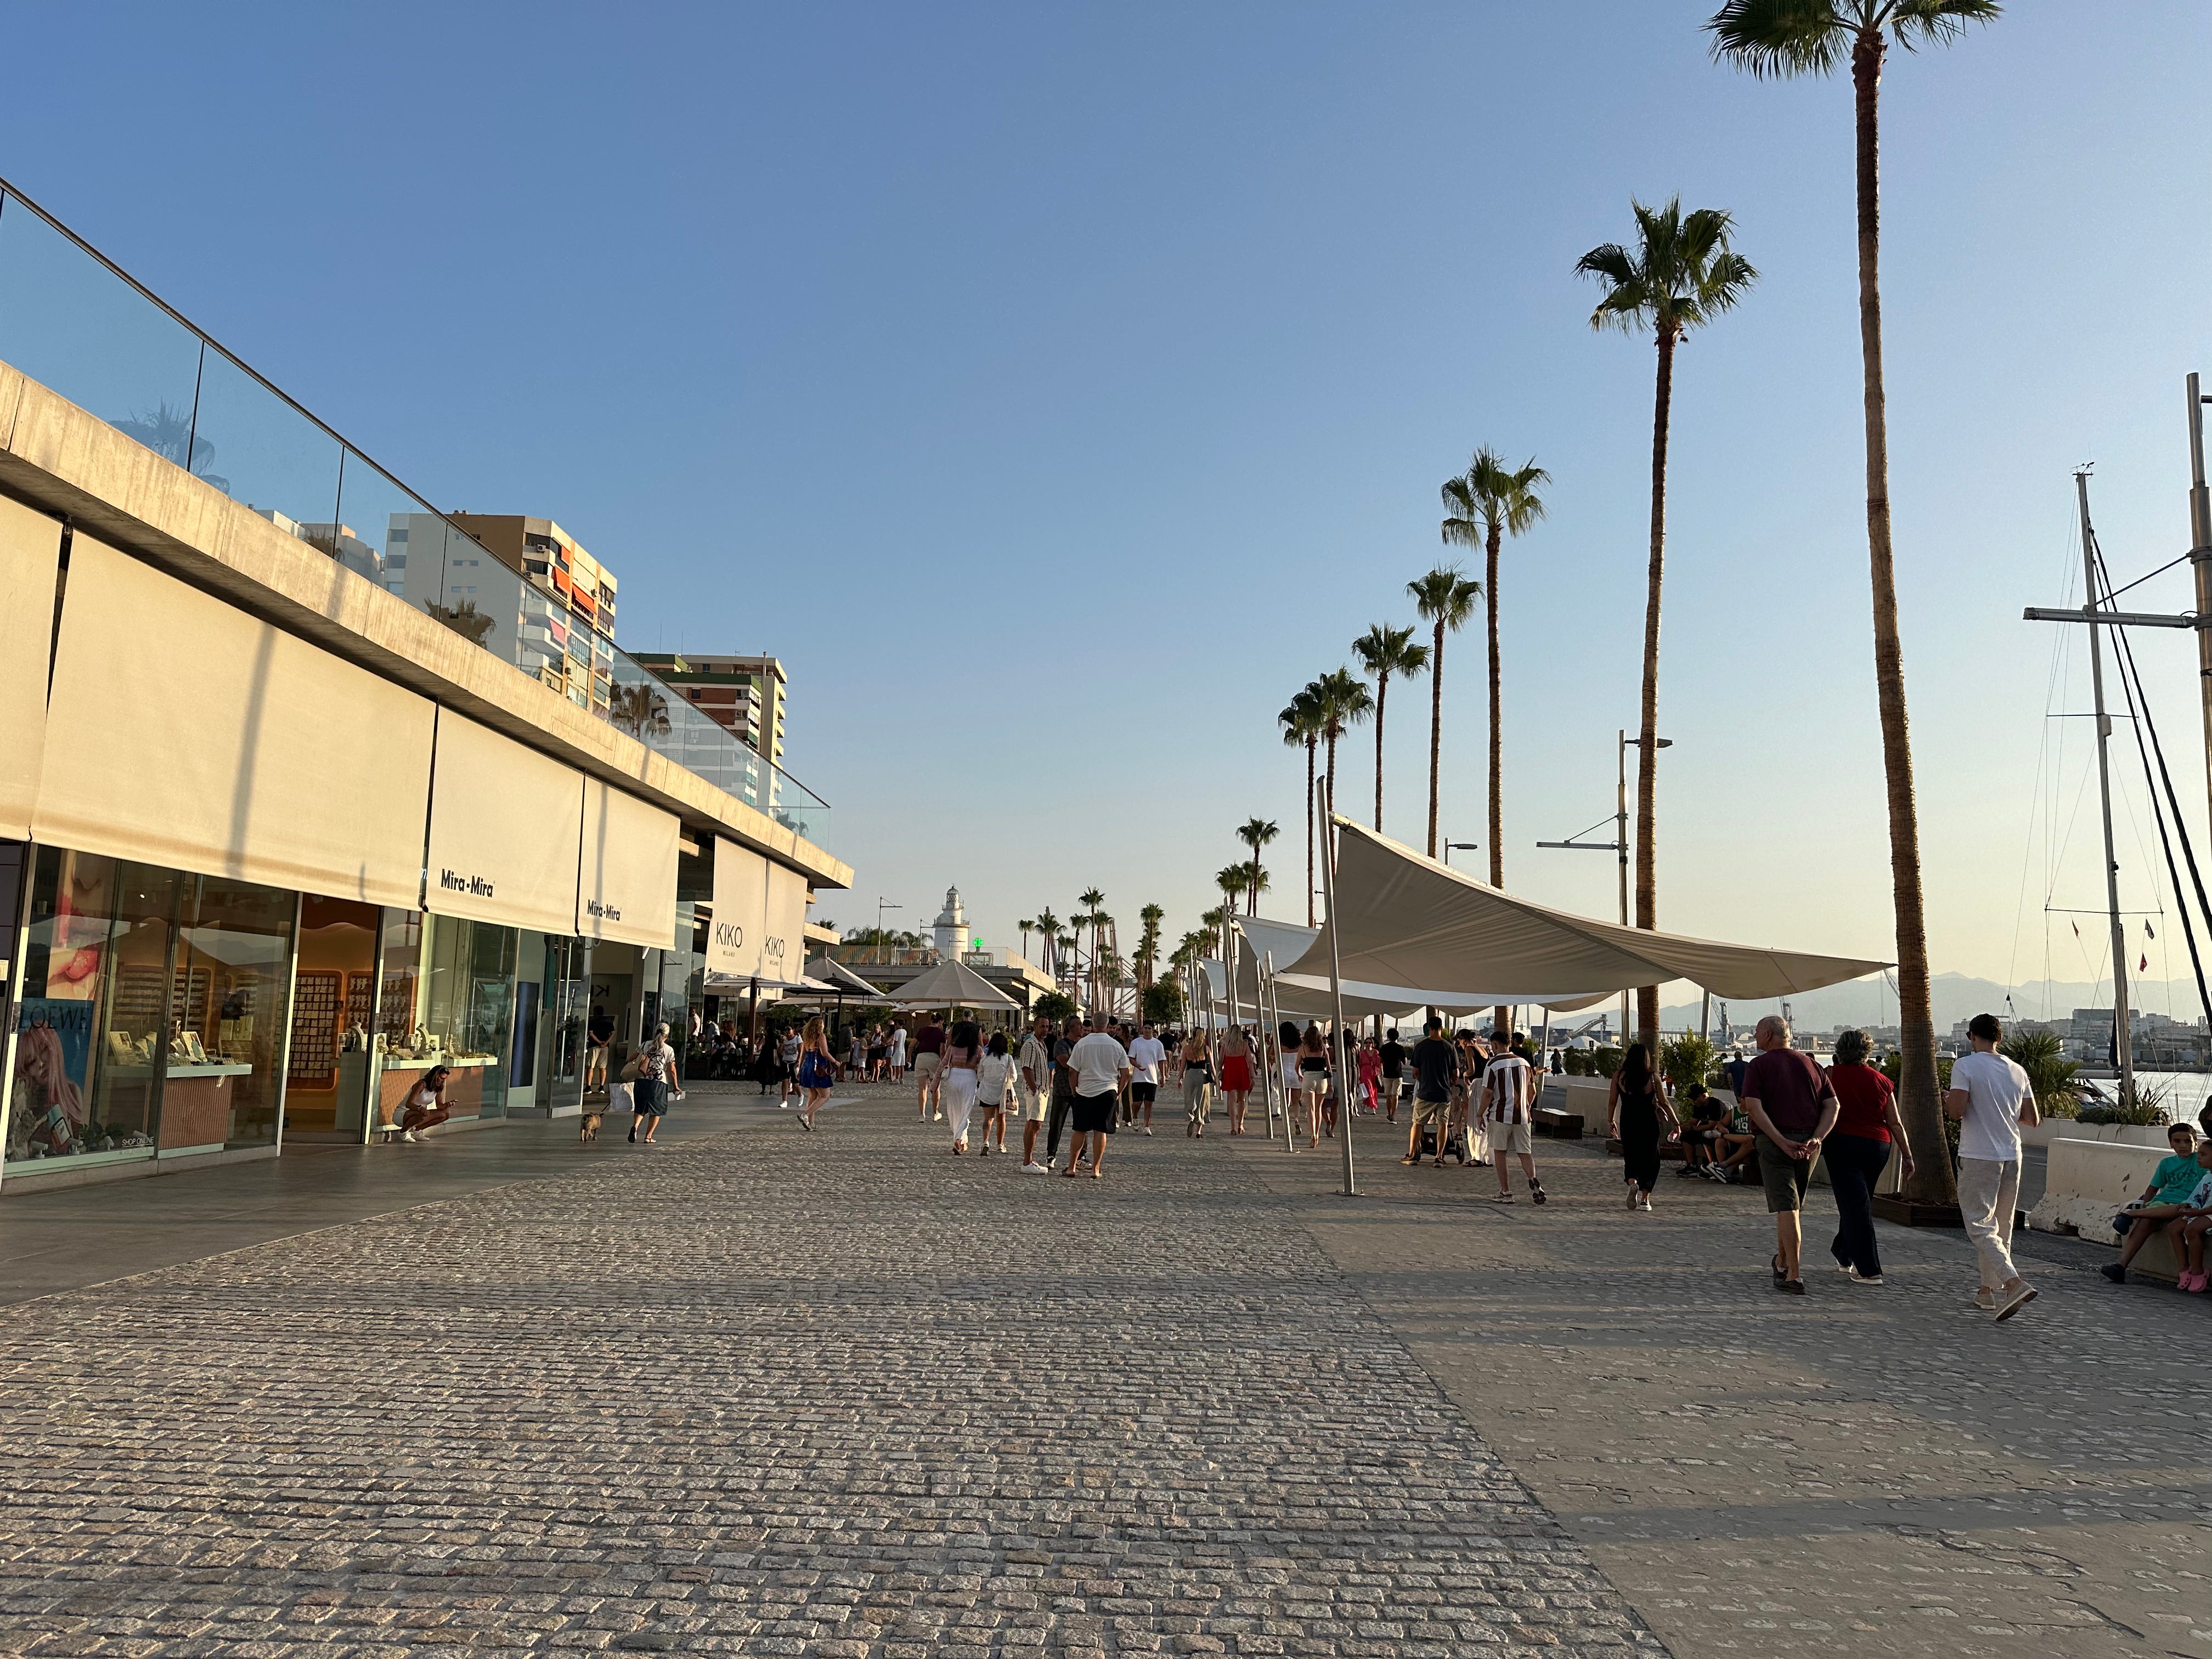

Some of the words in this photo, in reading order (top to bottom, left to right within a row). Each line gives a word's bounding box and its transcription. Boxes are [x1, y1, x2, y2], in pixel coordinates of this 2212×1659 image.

[716, 922, 742, 948] KIKO
[765, 935, 785, 958] KIKO
[19, 1005, 89, 1030] LOEWE
